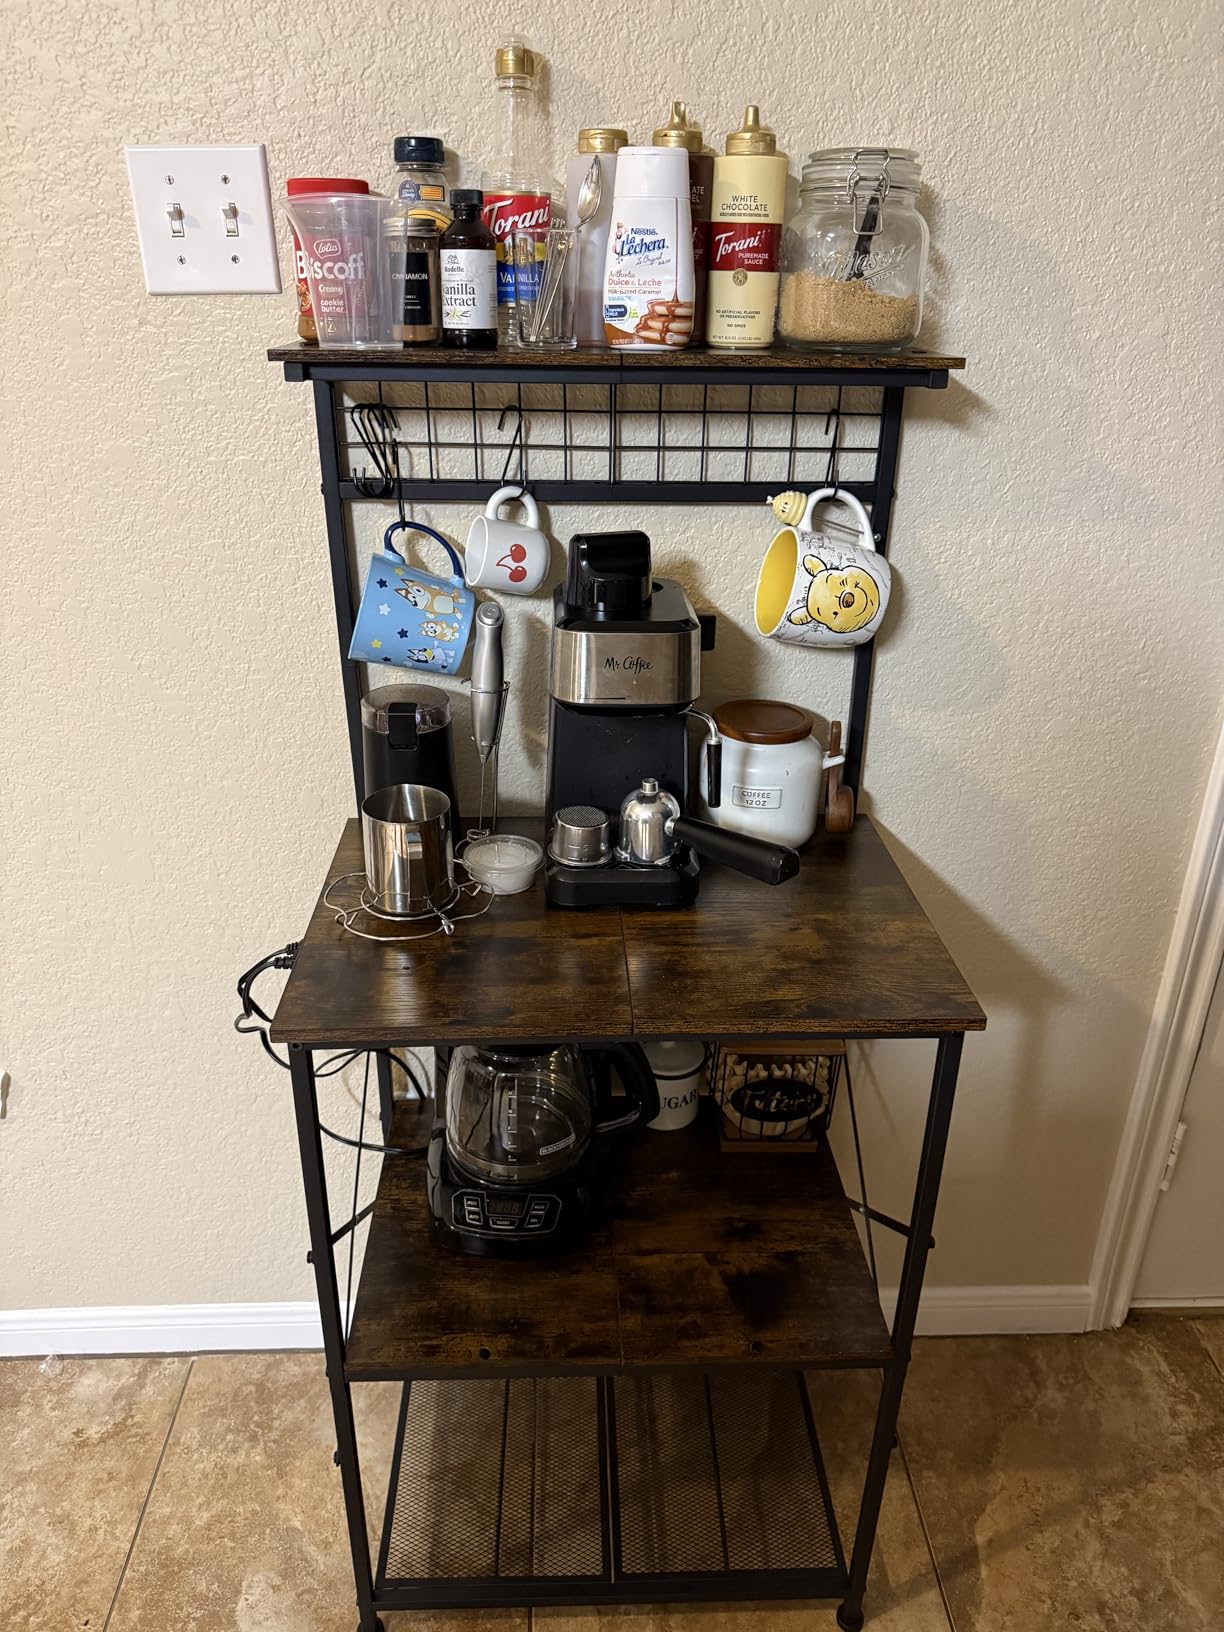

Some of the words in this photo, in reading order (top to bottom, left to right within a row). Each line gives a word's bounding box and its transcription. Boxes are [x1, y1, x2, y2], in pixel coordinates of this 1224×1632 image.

[732, 195, 758, 203] WHITE
[721, 203, 768, 212] CHOCOLATE
[484, 199, 549, 237] Torani
[626, 233, 636, 246] La
[714, 229, 762, 263] Torani
[318, 241, 338, 254] Lotus
[620, 238, 666, 257] Lechera
[296, 250, 364, 280] Biscoff
[637, 278, 662, 287] Leche
[321, 305, 344, 313] butter
[623, 656, 654, 675] Coffee
[741, 790, 771, 799] COFFEE
[662, 1088, 697, 1111] UGAR
